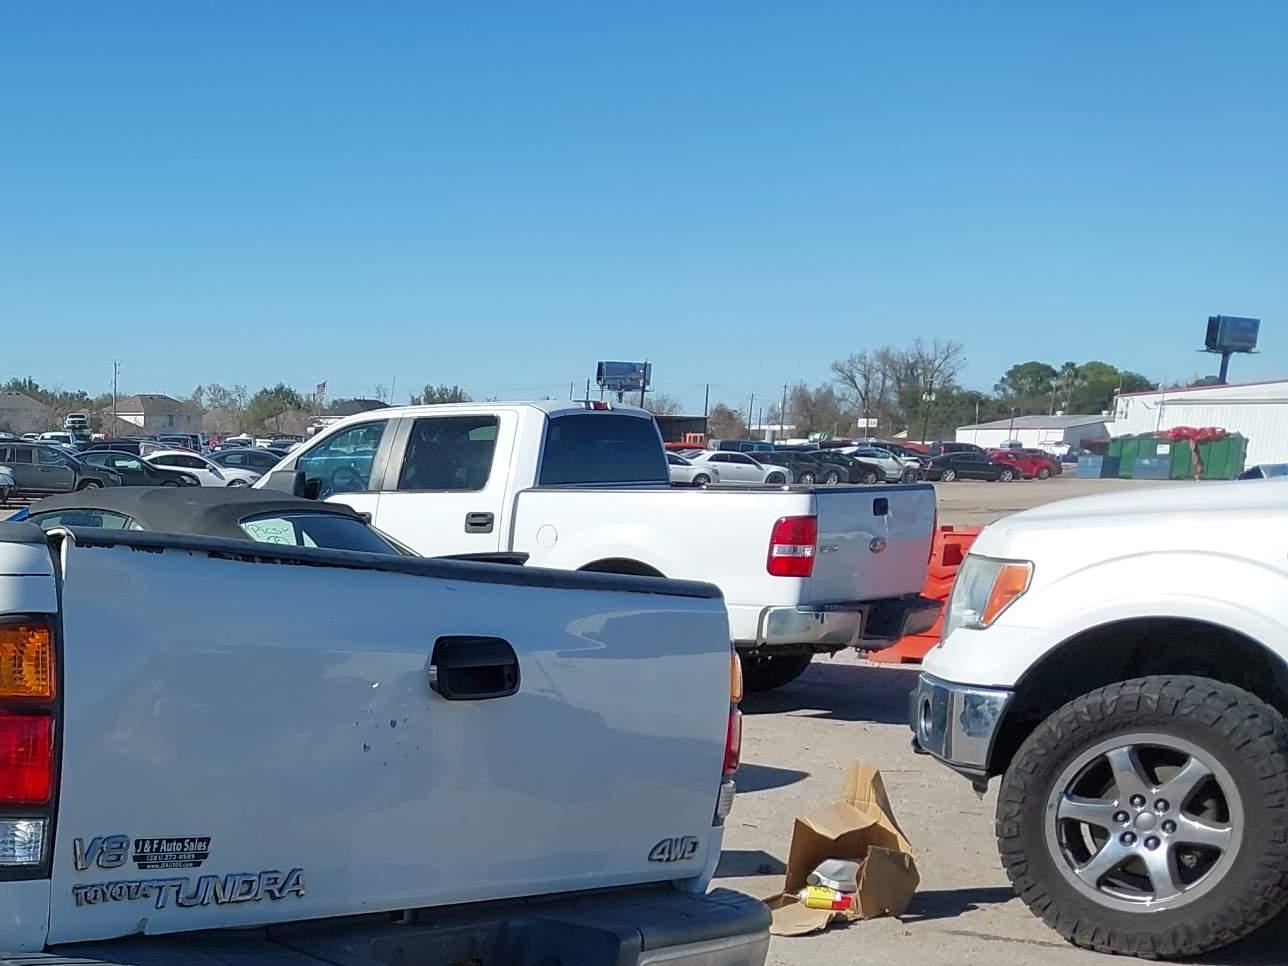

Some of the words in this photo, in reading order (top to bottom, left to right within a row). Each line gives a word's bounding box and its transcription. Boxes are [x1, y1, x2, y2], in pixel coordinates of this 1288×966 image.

[73, 834, 130, 871] V8
[136, 839, 143, 853] J
[143, 839, 152, 853] &
[152, 839, 160, 852] F
[159, 839, 183, 852] Auto
[183, 838, 208, 852] Sales
[73, 880, 151, 906] TOYOTA
[146, 868, 306, 909] TUNDRA
